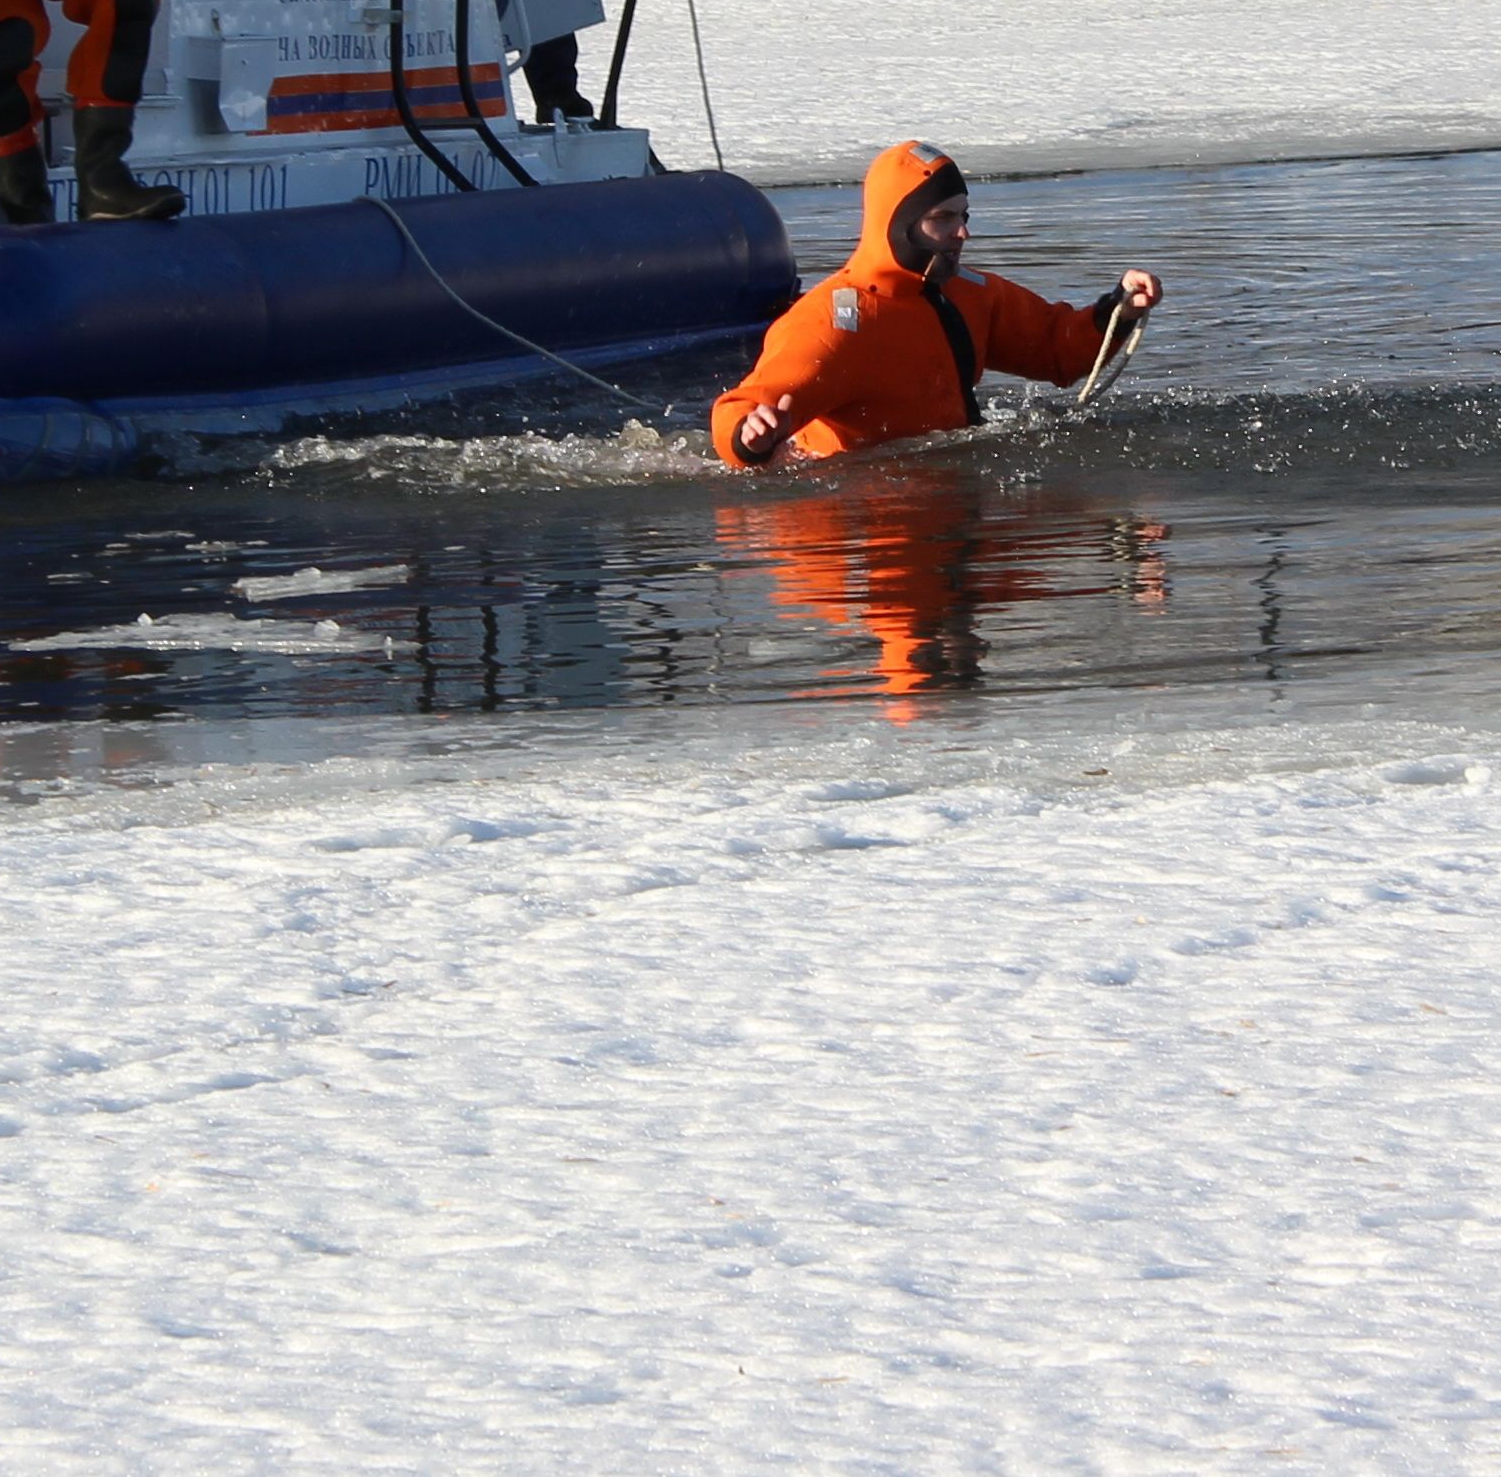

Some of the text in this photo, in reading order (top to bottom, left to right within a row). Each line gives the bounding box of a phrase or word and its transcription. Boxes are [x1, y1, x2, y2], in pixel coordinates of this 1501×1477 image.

[278, 36, 301, 62] НА
[308, 34, 377, 62] ВОДНЫХ
[249, 163, 287, 211] 101
